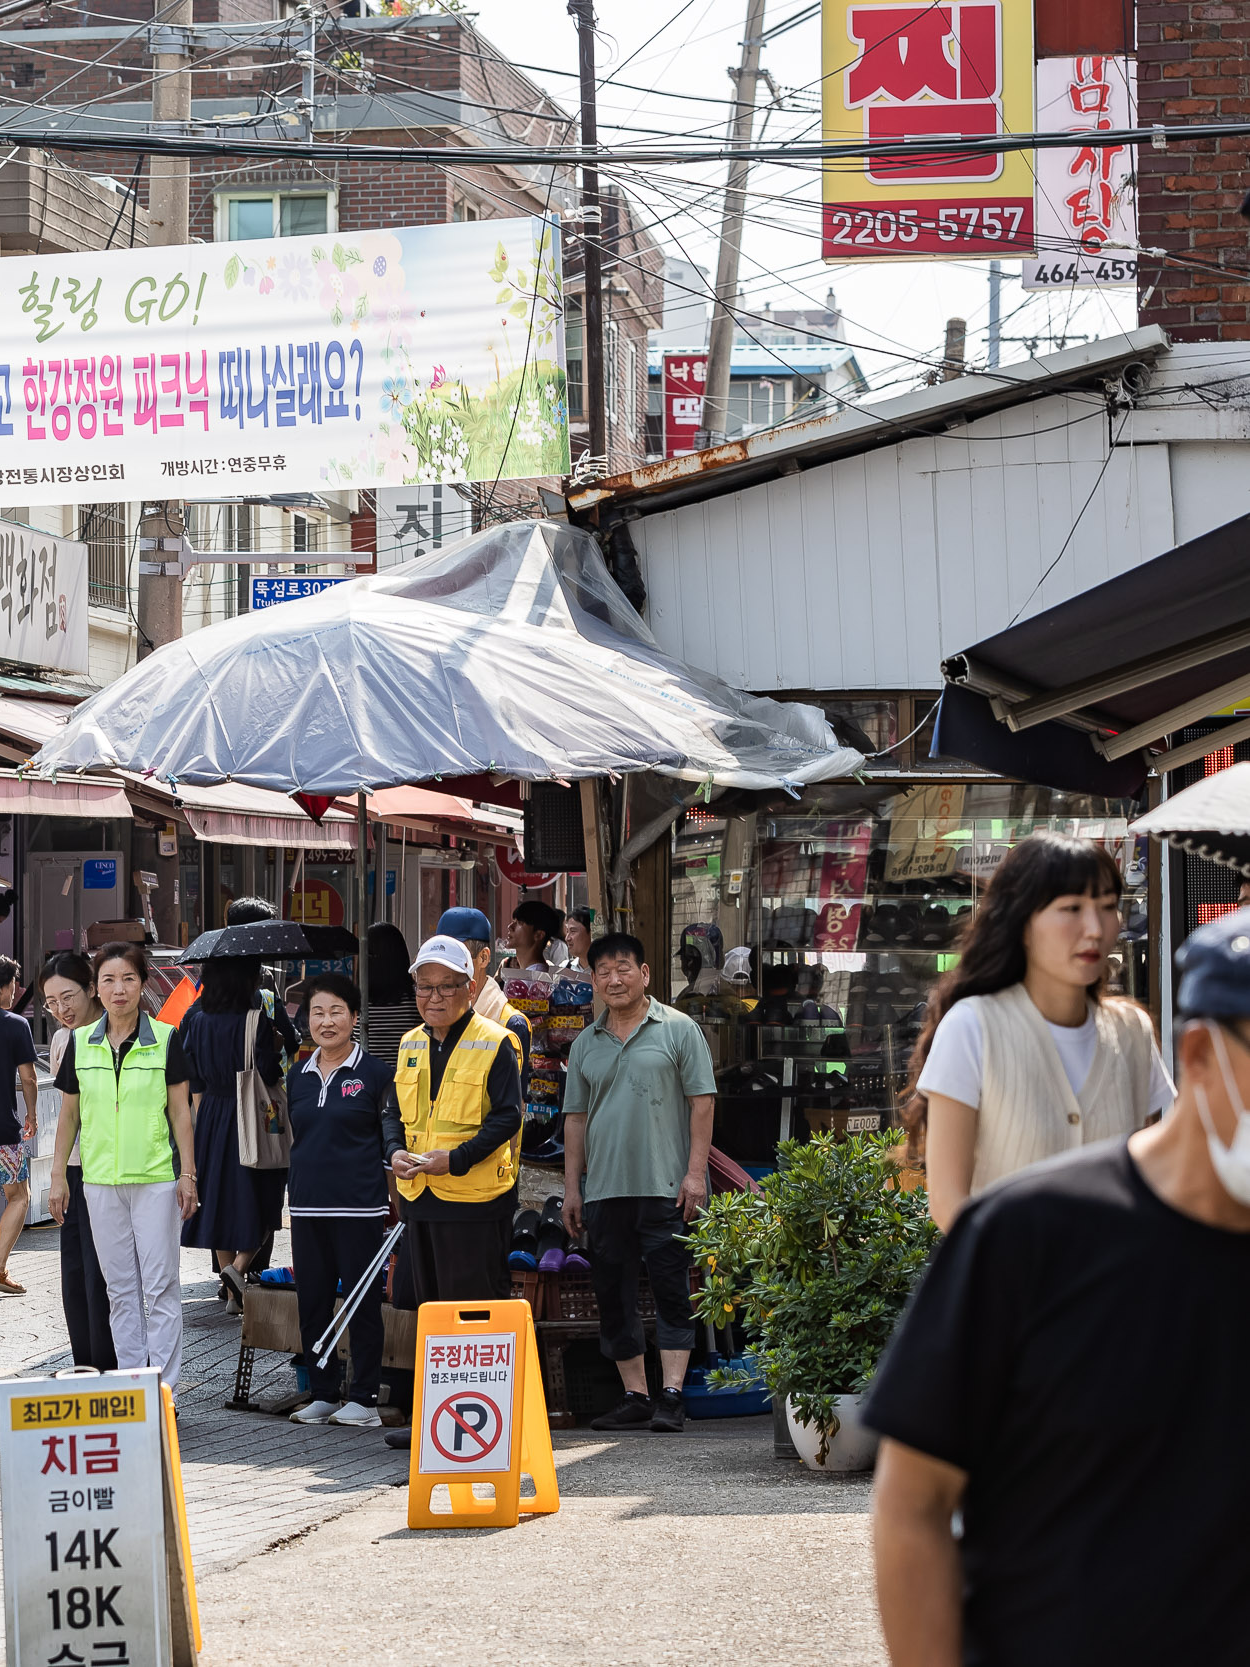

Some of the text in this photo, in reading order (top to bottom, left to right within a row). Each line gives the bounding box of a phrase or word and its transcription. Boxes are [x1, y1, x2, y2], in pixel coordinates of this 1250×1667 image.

[831, 207, 1025, 245] 2205-5757
[124, 271, 209, 326] GO!
[23, 355, 124, 441] 한강정원
[133, 350, 210, 435] 피크닉
[218, 338, 364, 430] 떠나실래요?
[430, 1343, 511, 1369] 주정차금지
[431, 1370, 507, 1384] 협조부탁드립니다
[23, 1396, 135, 1423] 최고가 매입!
[40, 1432, 121, 1475] 치금
[48, 1486, 115, 1513] 금이빨
[45, 1527, 123, 1572] 14K
[47, 1585, 125, 1630] 18K
